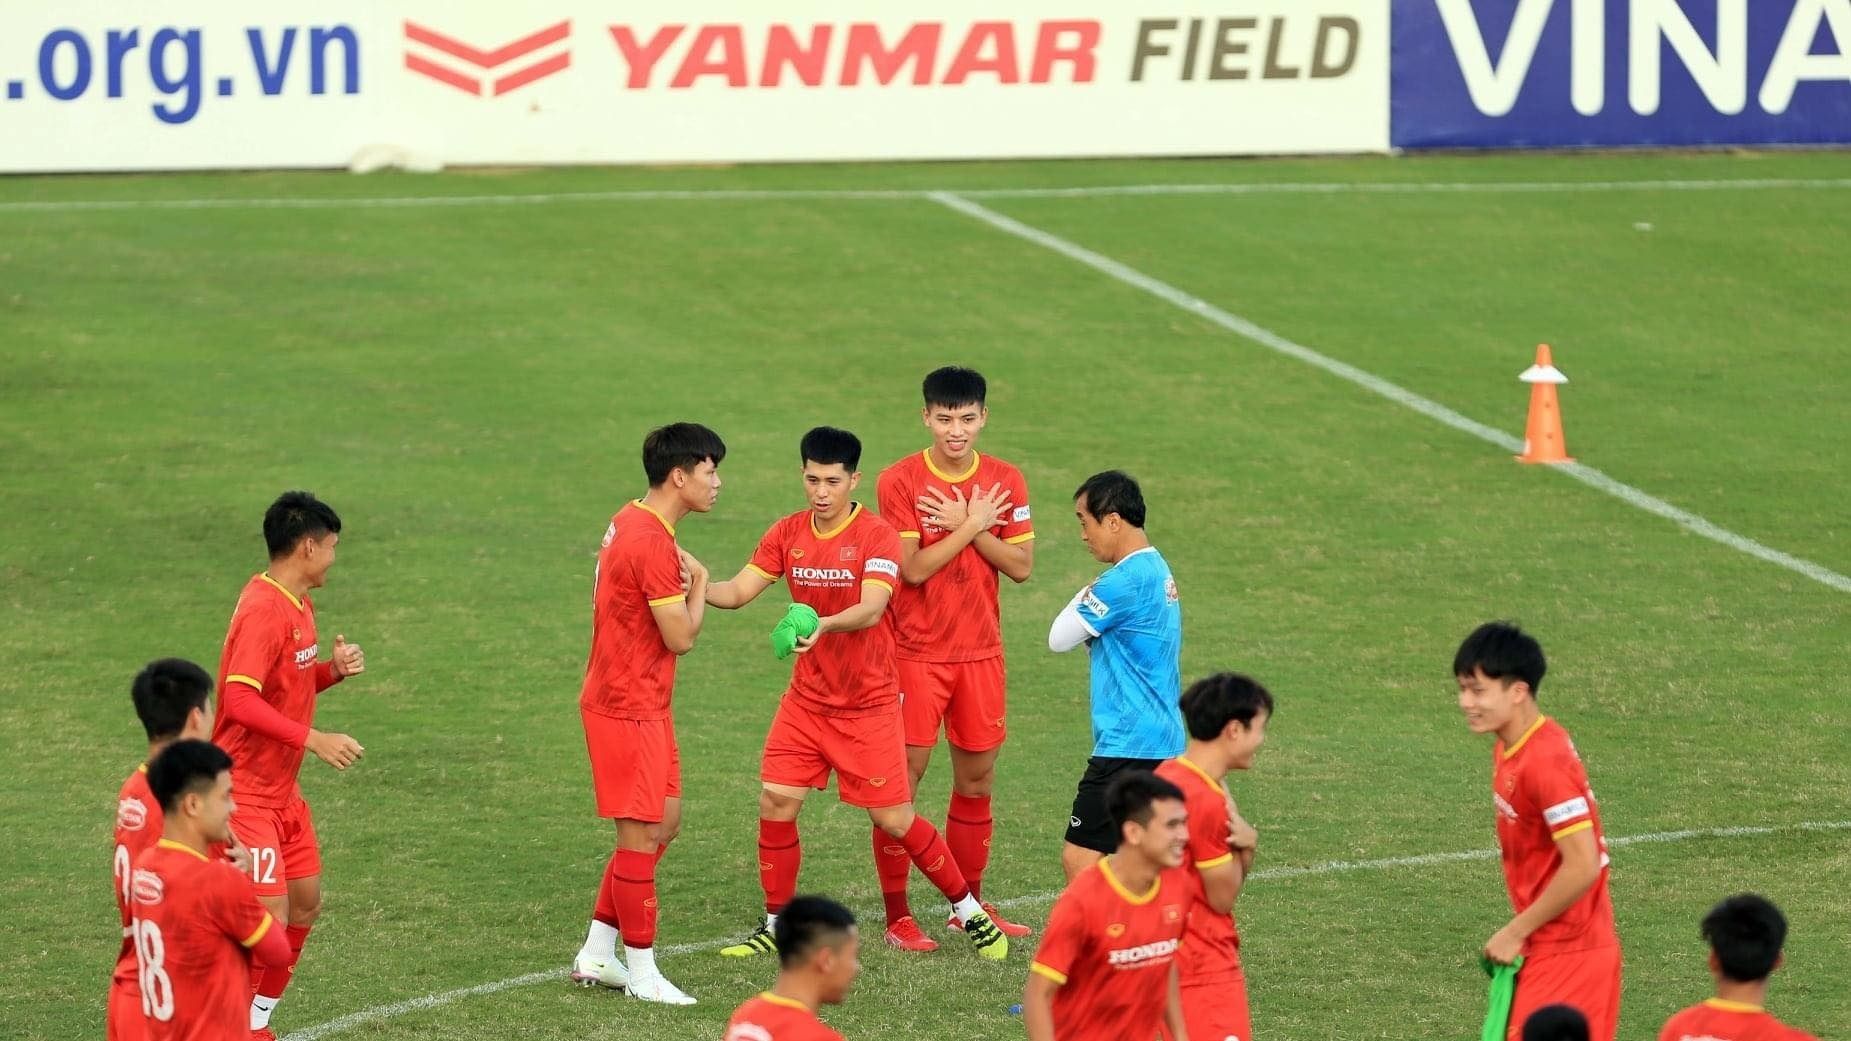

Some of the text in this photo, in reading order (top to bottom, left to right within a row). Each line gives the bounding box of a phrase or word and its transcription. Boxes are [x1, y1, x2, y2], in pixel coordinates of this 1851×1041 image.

[607, 15, 1360, 89] YANMAR FIELD
[791, 566, 856, 580] HONDA
[249, 847, 277, 884] 12
[132, 917, 175, 1021] 18
